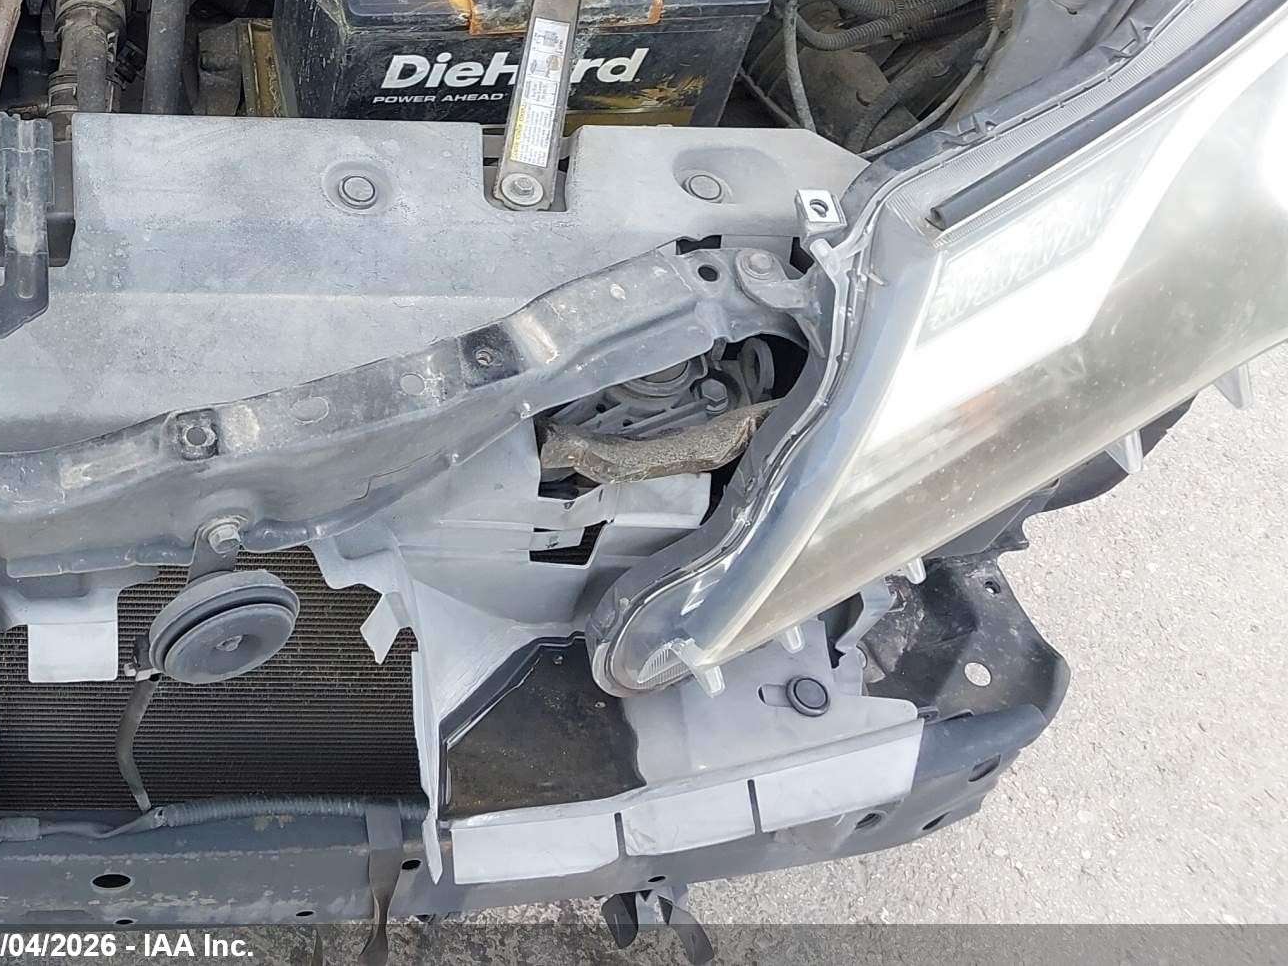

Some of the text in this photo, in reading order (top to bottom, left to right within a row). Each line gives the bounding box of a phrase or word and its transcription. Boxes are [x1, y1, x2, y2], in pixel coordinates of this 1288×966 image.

[381, 48, 649, 88] DieHrd
[372, 92, 504, 104] POWER AHEAD
